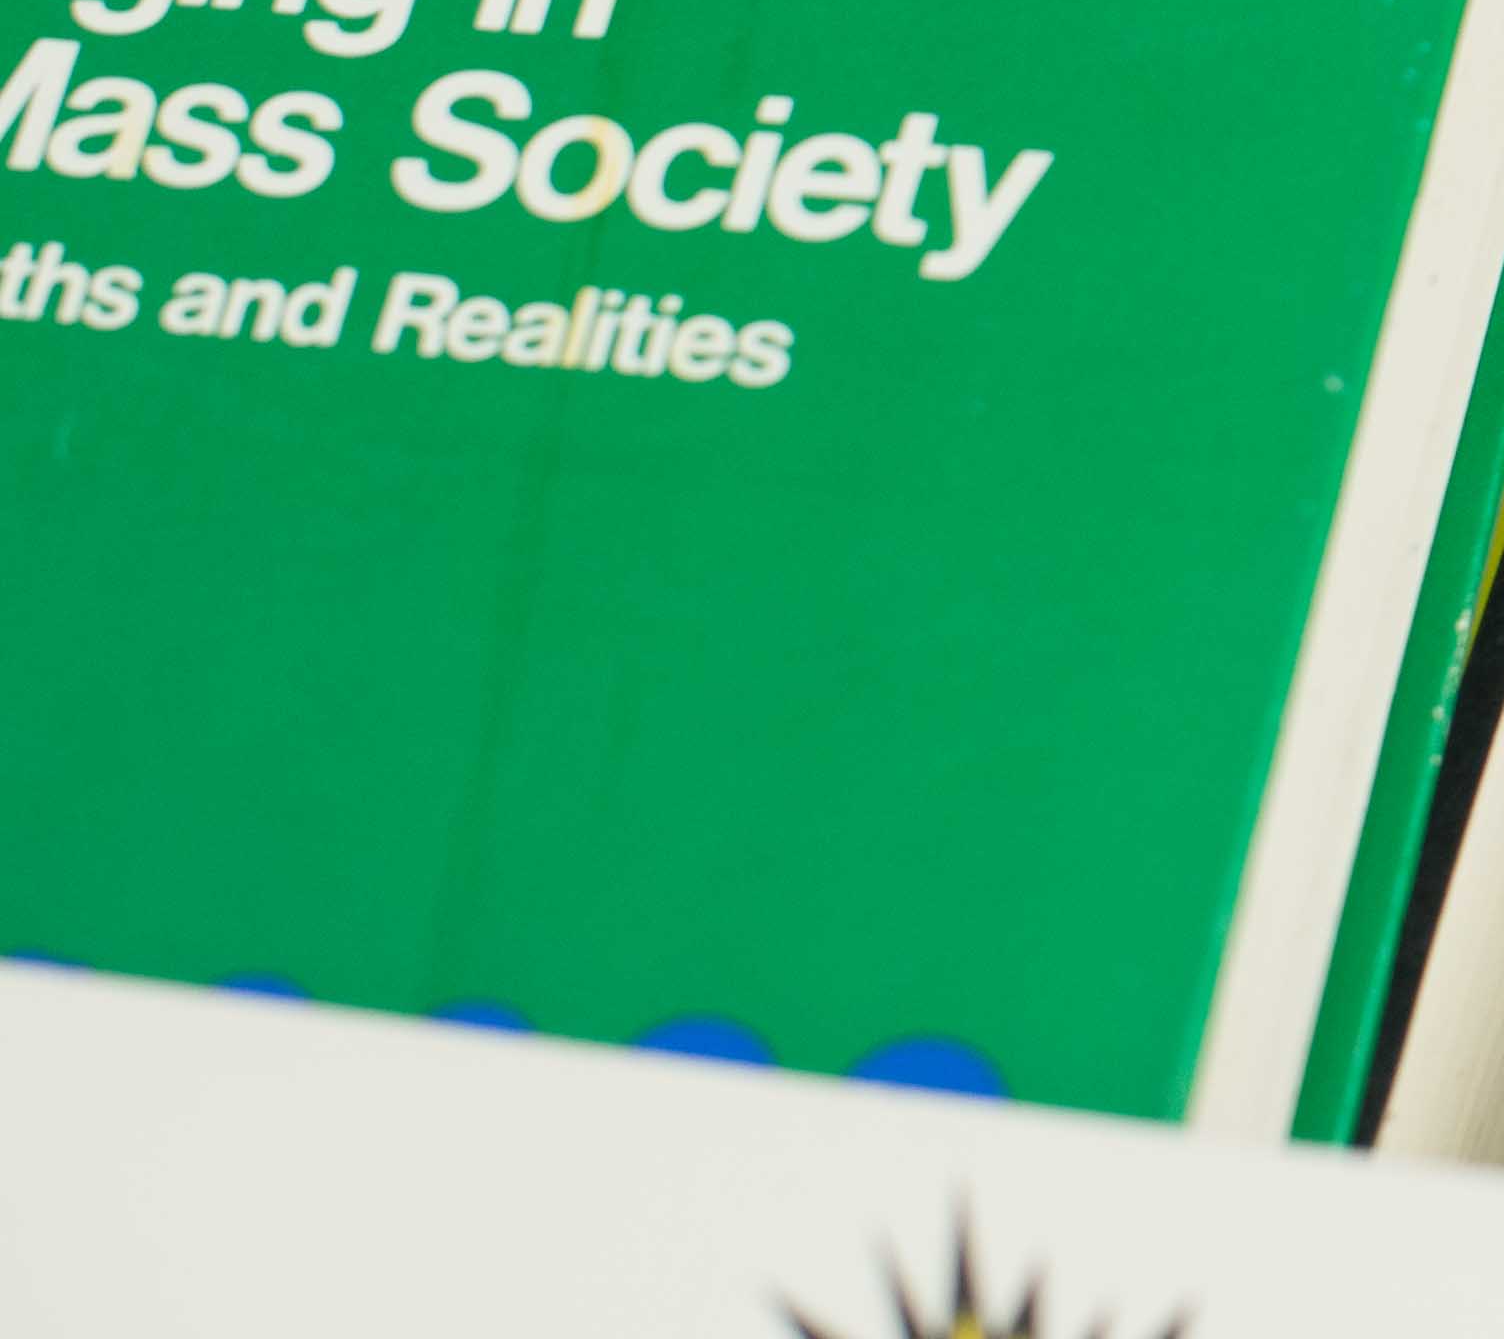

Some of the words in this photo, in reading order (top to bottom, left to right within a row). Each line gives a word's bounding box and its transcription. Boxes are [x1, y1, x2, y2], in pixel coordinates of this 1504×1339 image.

[388, 68, 1056, 283] Society
[158, 264, 359, 349] and
[372, 271, 797, 390] Realities
